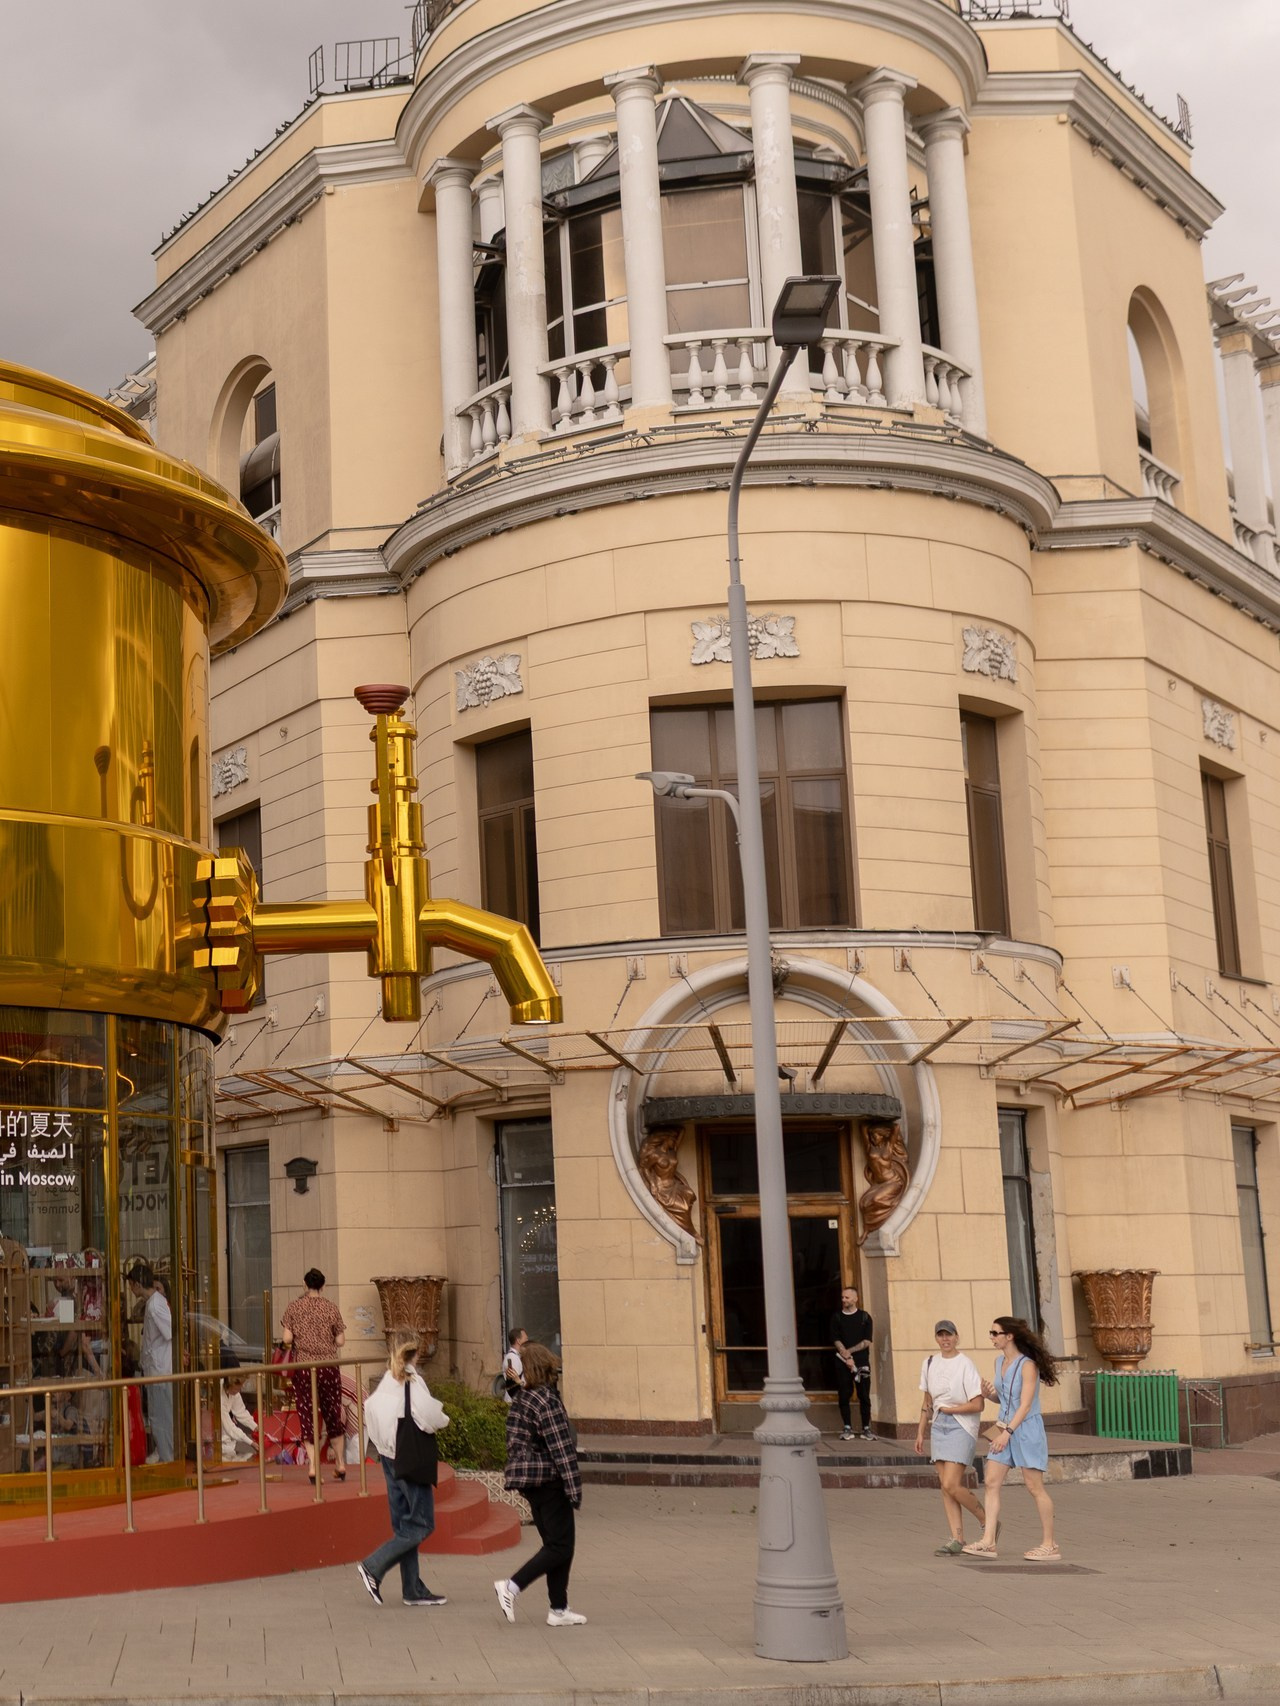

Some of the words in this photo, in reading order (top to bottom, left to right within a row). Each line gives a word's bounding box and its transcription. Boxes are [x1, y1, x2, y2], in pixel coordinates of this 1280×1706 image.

[27, 1143, 74, 1162] الصيف
[0, 1170, 14, 1186] in
[19, 1171, 76, 1186] Moscow
